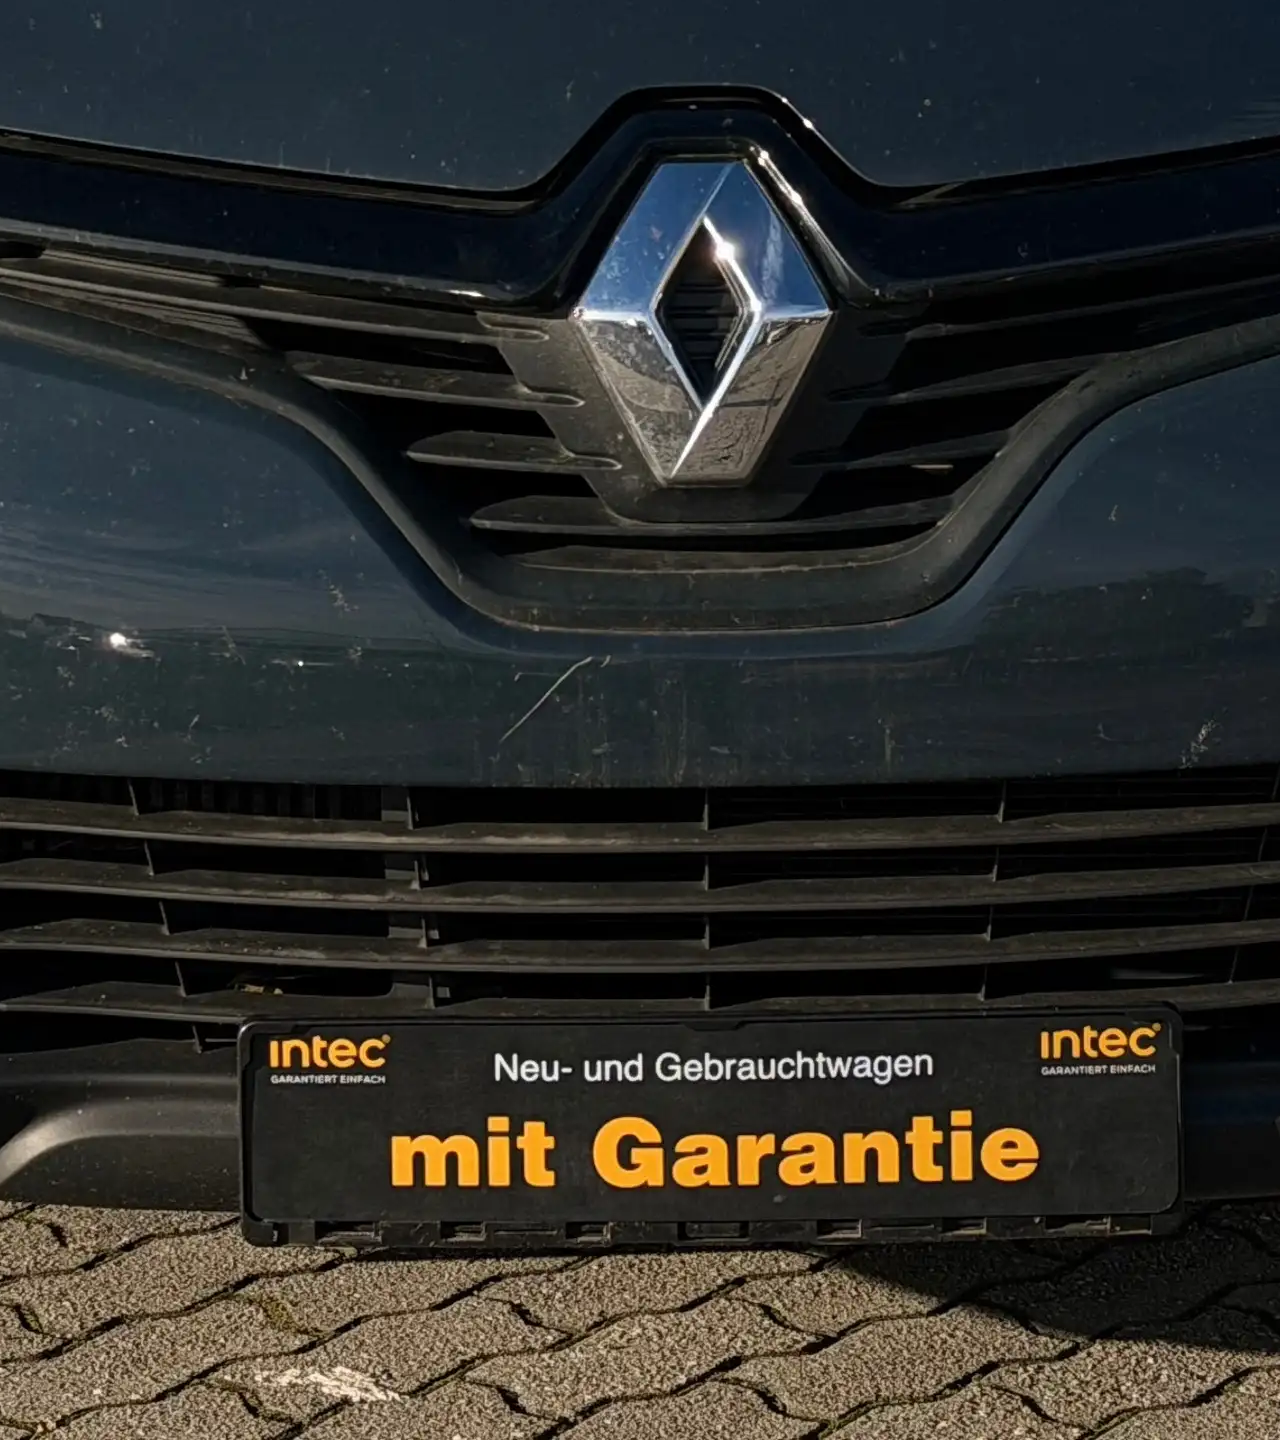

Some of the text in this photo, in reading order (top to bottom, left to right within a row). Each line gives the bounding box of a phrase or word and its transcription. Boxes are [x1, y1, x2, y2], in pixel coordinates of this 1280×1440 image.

[270, 1074, 386, 1084] GARANTIERT EINFACH
[494, 1050, 933, 1085] Neu- und Gebrauchtwagen
[1040, 1063, 1156, 1076] GARANTIERT EINFACH
[391, 1109, 1040, 1189] mit Garantie
